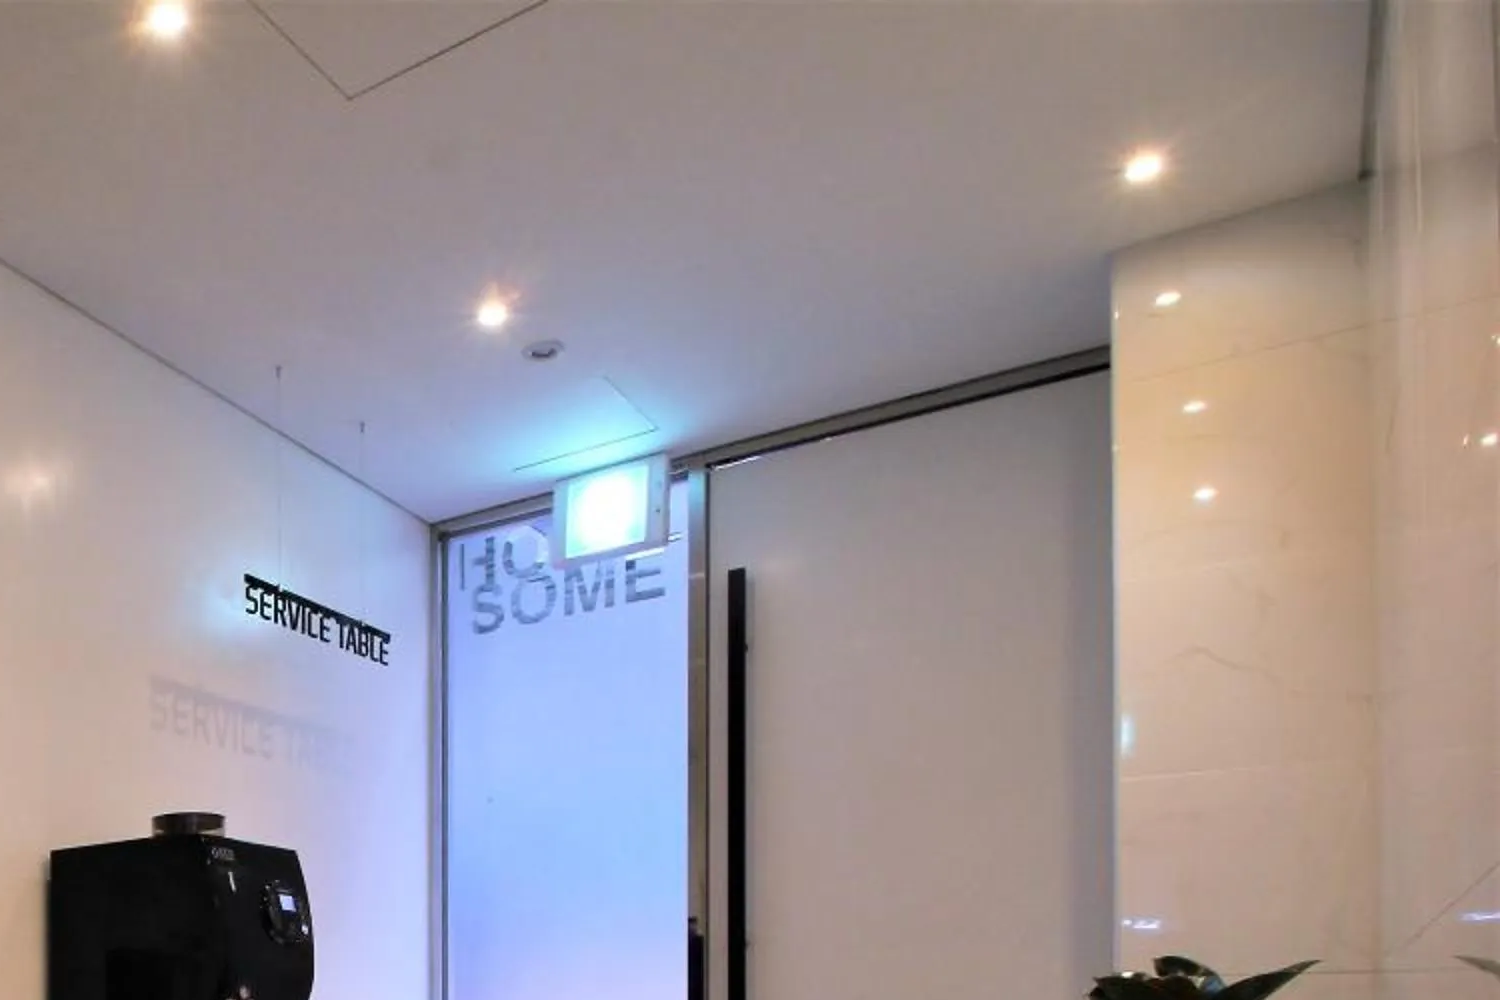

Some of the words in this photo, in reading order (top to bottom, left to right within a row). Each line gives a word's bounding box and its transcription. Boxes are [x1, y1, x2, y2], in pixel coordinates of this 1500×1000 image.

[245, 583, 331, 644] SERVICE
[336, 617, 389, 666] TABLE
[472, 548, 666, 635] SOME
